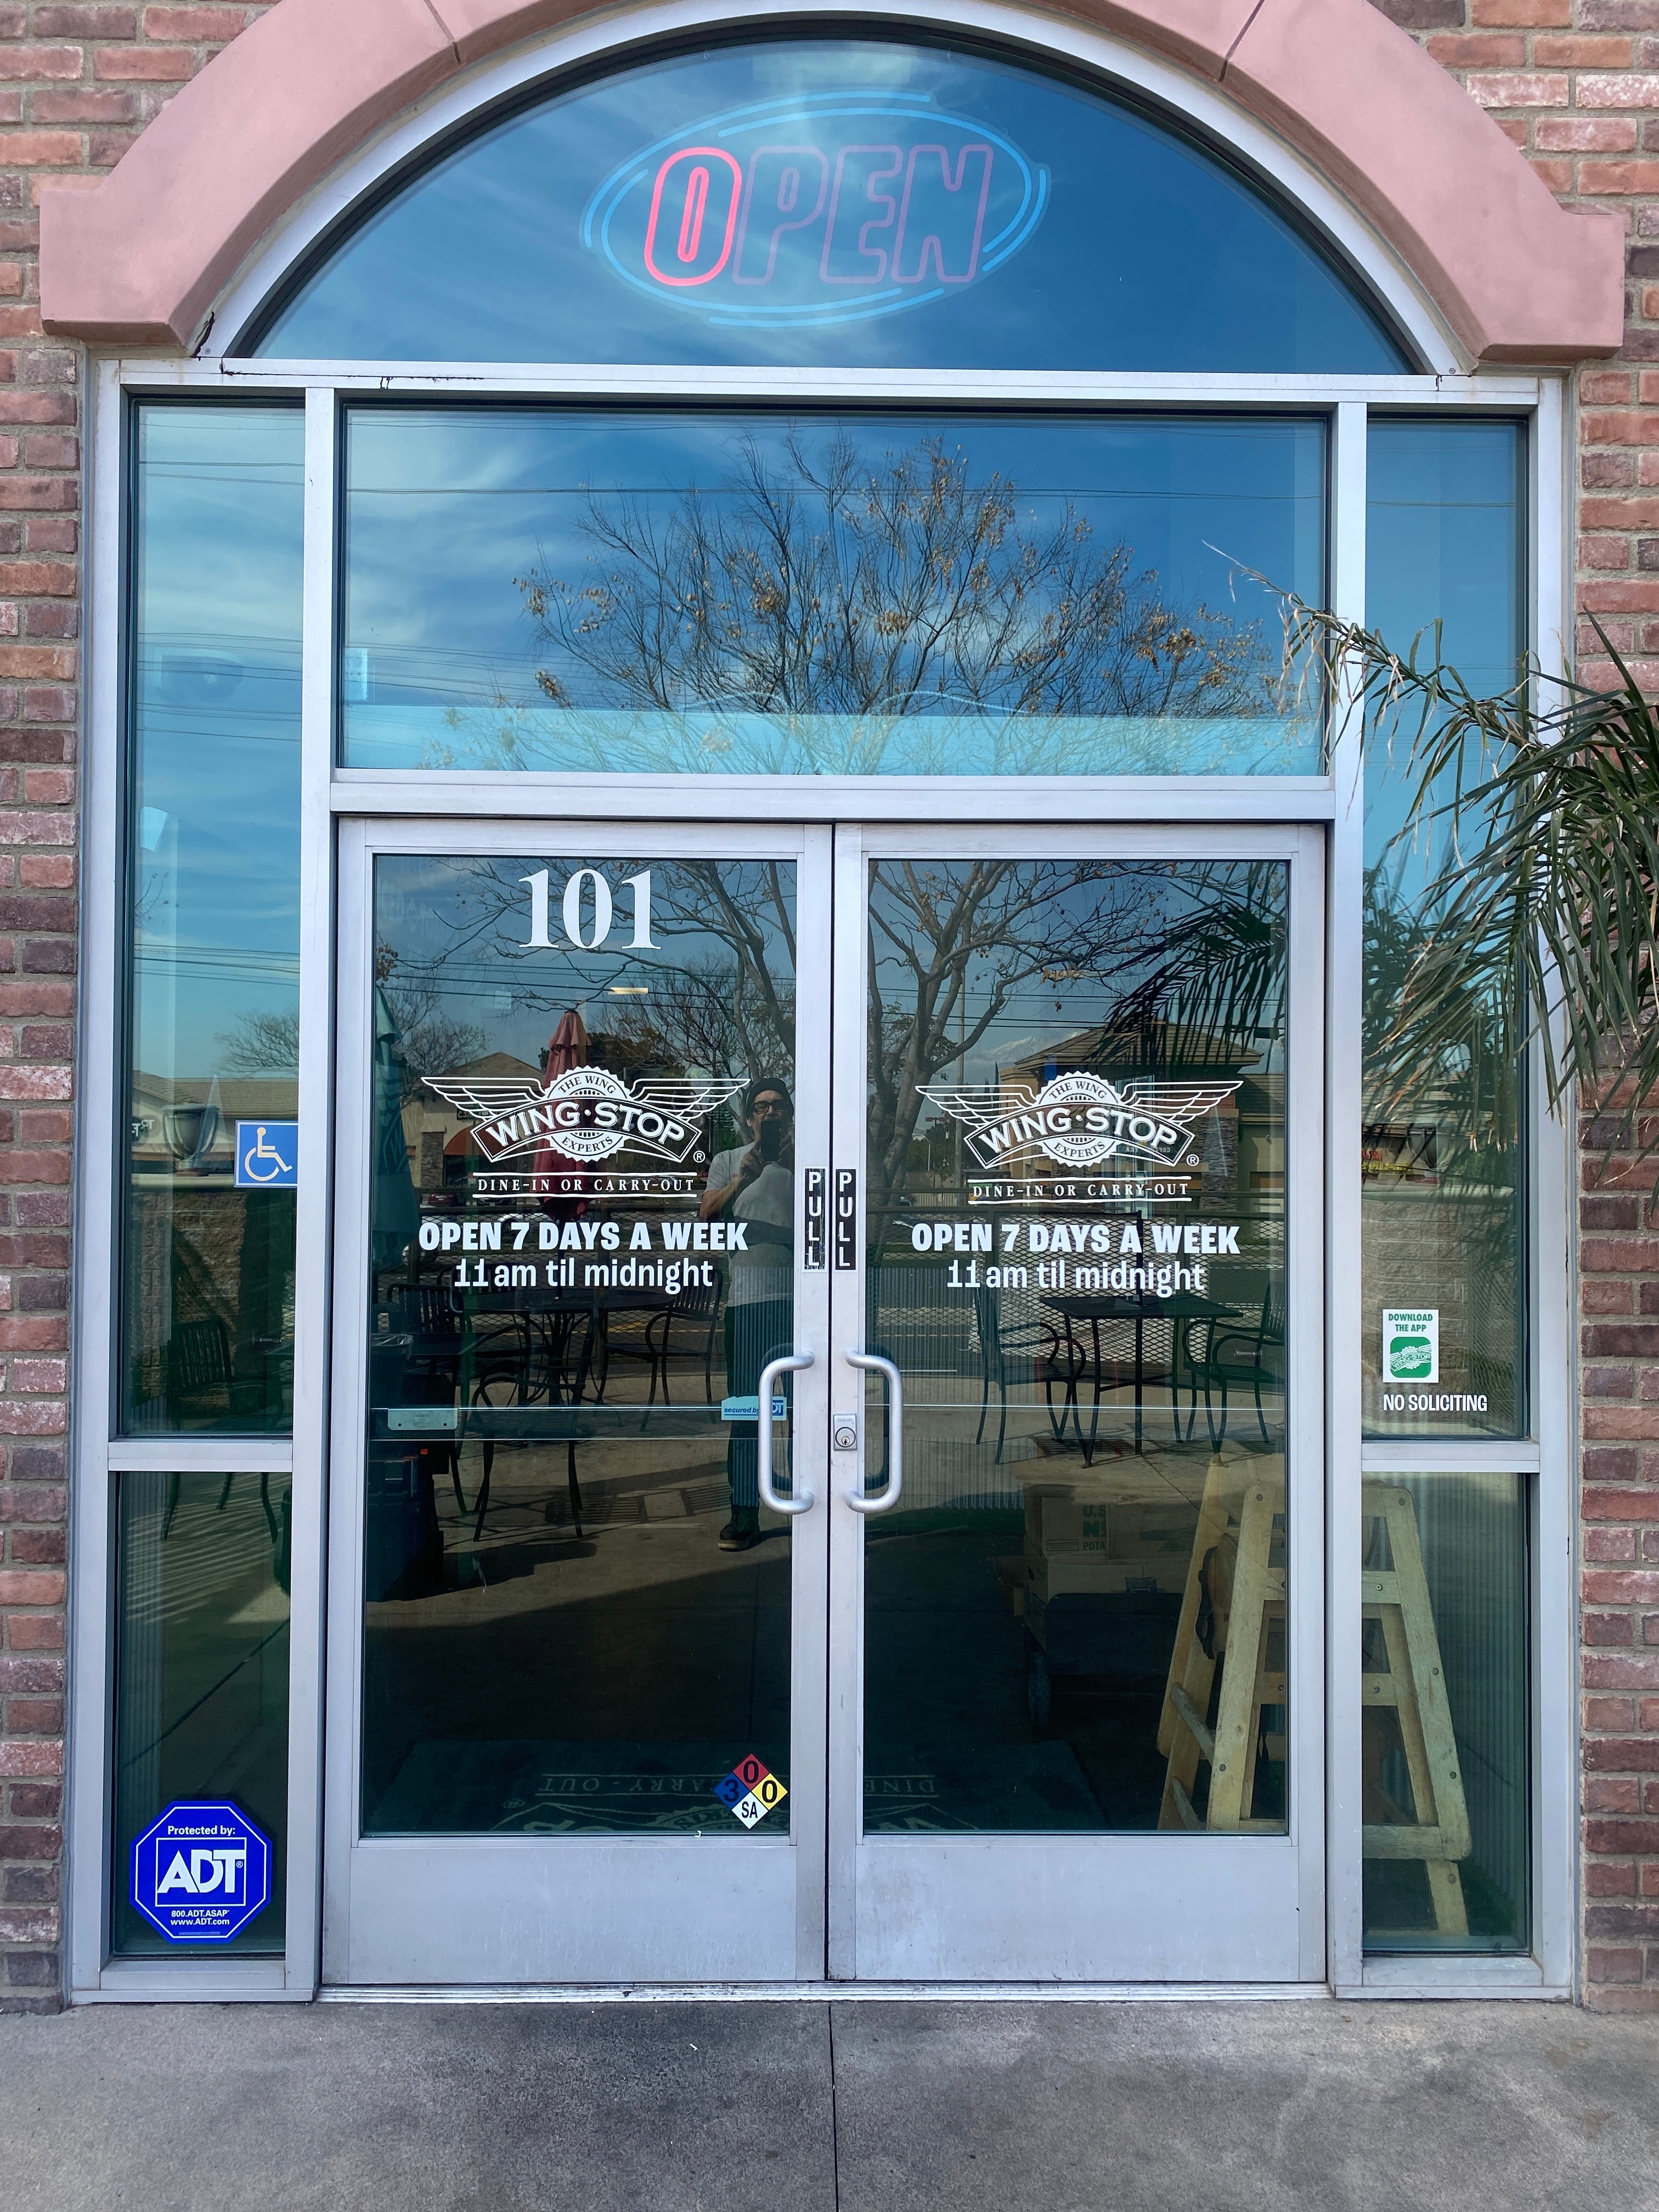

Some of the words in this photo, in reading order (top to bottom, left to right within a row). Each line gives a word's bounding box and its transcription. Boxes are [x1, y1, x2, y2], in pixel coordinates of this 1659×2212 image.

[645, 144, 994, 286] OPEN
[518, 869, 662, 950] 101
[558, 1076, 582, 1093] THE
[585, 1076, 616, 1094] WING
[1049, 1082, 1072, 1099] THE
[1075, 1081, 1107, 1099] WING
[561, 1136, 613, 1152] EXPERTS
[1053, 1141, 1105, 1157] EXPERTS
[478, 1178, 550, 1191] DINE-IN
[561, 1178, 583, 1191] OR
[594, 1178, 695, 1192] CARRY-OUT
[973, 1184, 1044, 1198] DINE-IN
[1054, 1184, 1076, 1197] OR
[1087, 1183, 1188, 1197] CARRY-OUT
[808, 1172, 822, 1267] PULL
[839, 1172, 853, 1267] PULL
[419, 1222, 501, 1251] OPEN
[510, 1222, 530, 1251] 7
[539, 1222, 620, 1251] DAYS
[629, 1222, 652, 1250] A
[662, 1222, 748, 1251] WEEK
[912, 1223, 992, 1252] OPEN
[1001, 1223, 1020, 1252] 7
[1029, 1224, 1110, 1253] DAYS
[1119, 1224, 1143, 1254] A
[1152, 1225, 1241, 1255] WEEK
[545, 1258, 575, 1287] til
[584, 1258, 713, 1295] midnight
[1036, 1260, 1065, 1289] til
[1075, 1260, 1205, 1299] midnight
[1388, 1313, 1433, 1322] DOWNLOAD
[1395, 1324, 1409, 1332] THE
[1410, 1324, 1427, 1332] APP
[1383, 1394, 1405, 1411] NO
[1408, 1394, 1488, 1412] SOLICITING
[1083, 1541, 1107, 1551] POTA
[743, 1760, 759, 1784] 0
[723, 1779, 740, 1803] 3
[761, 1780, 778, 1803] 0
[741, 1801, 758, 1819] SA
[167, 1825, 218, 1835] Protected
[220, 1825, 235, 1837] by:
[157, 1849, 245, 1893] ADT
